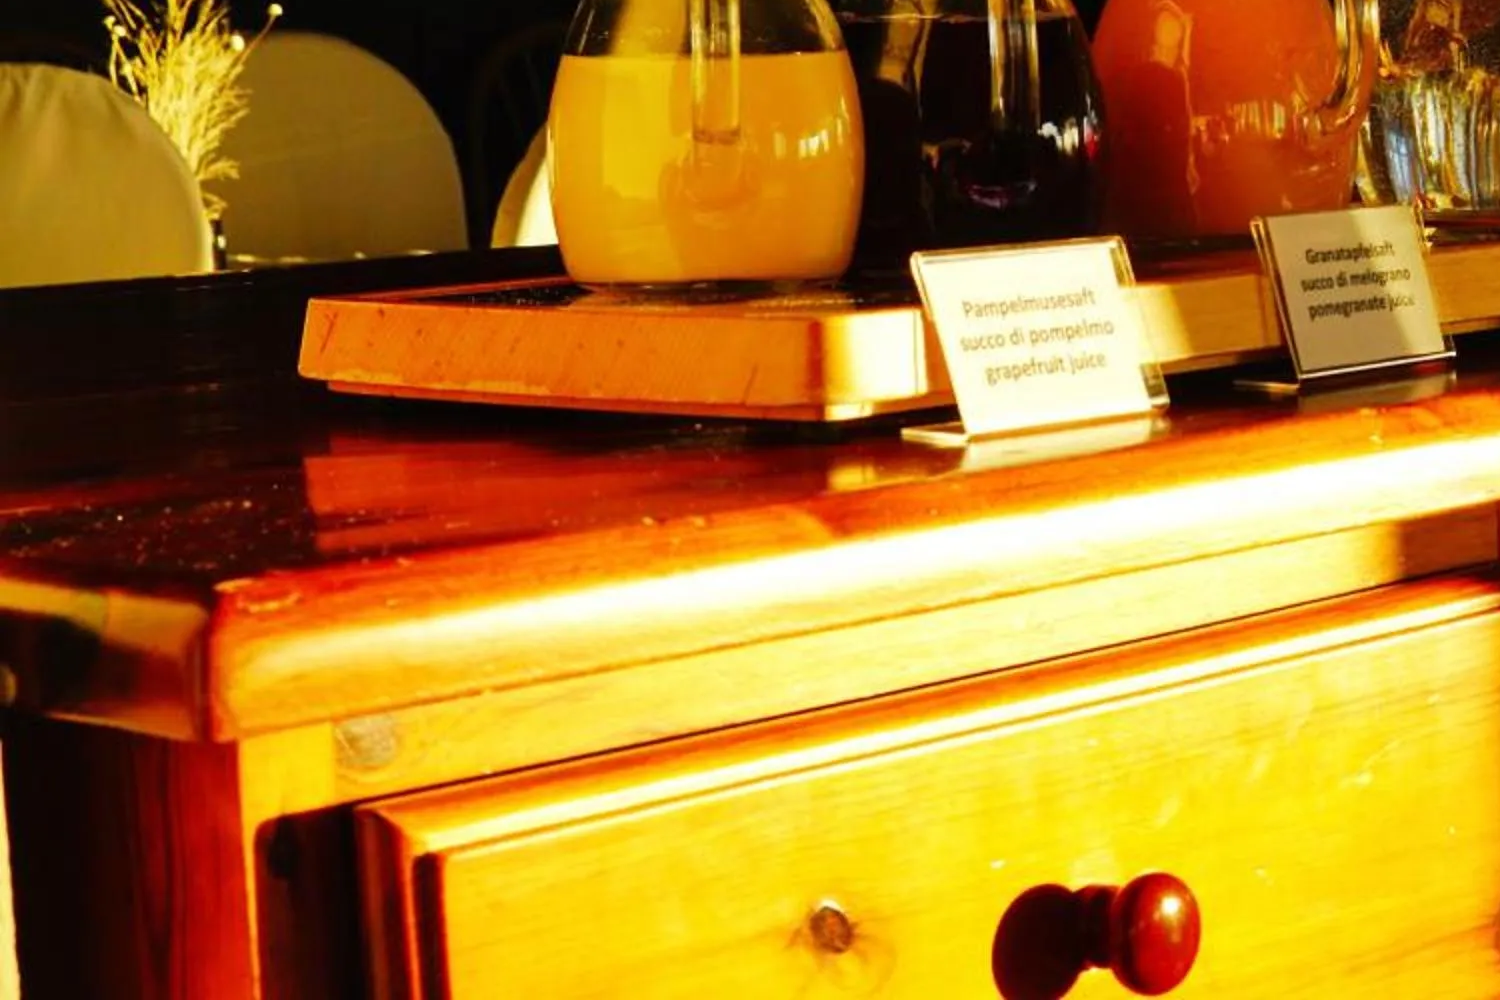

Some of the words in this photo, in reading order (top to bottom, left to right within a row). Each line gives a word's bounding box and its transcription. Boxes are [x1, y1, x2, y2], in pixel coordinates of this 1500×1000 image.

[1301, 278, 1335, 293] succo
[1336, 273, 1348, 289] di
[1349, 267, 1411, 287] melograno
[962, 288, 1096, 319] Pampelmusesaft
[1308, 296, 1387, 321] pomegranate
[960, 334, 1006, 352] succo
[1009, 327, 1025, 347] di
[1030, 318, 1114, 345] pompelmo
[985, 354, 1064, 386] grapefruit
[1069, 351, 1107, 376] juice
